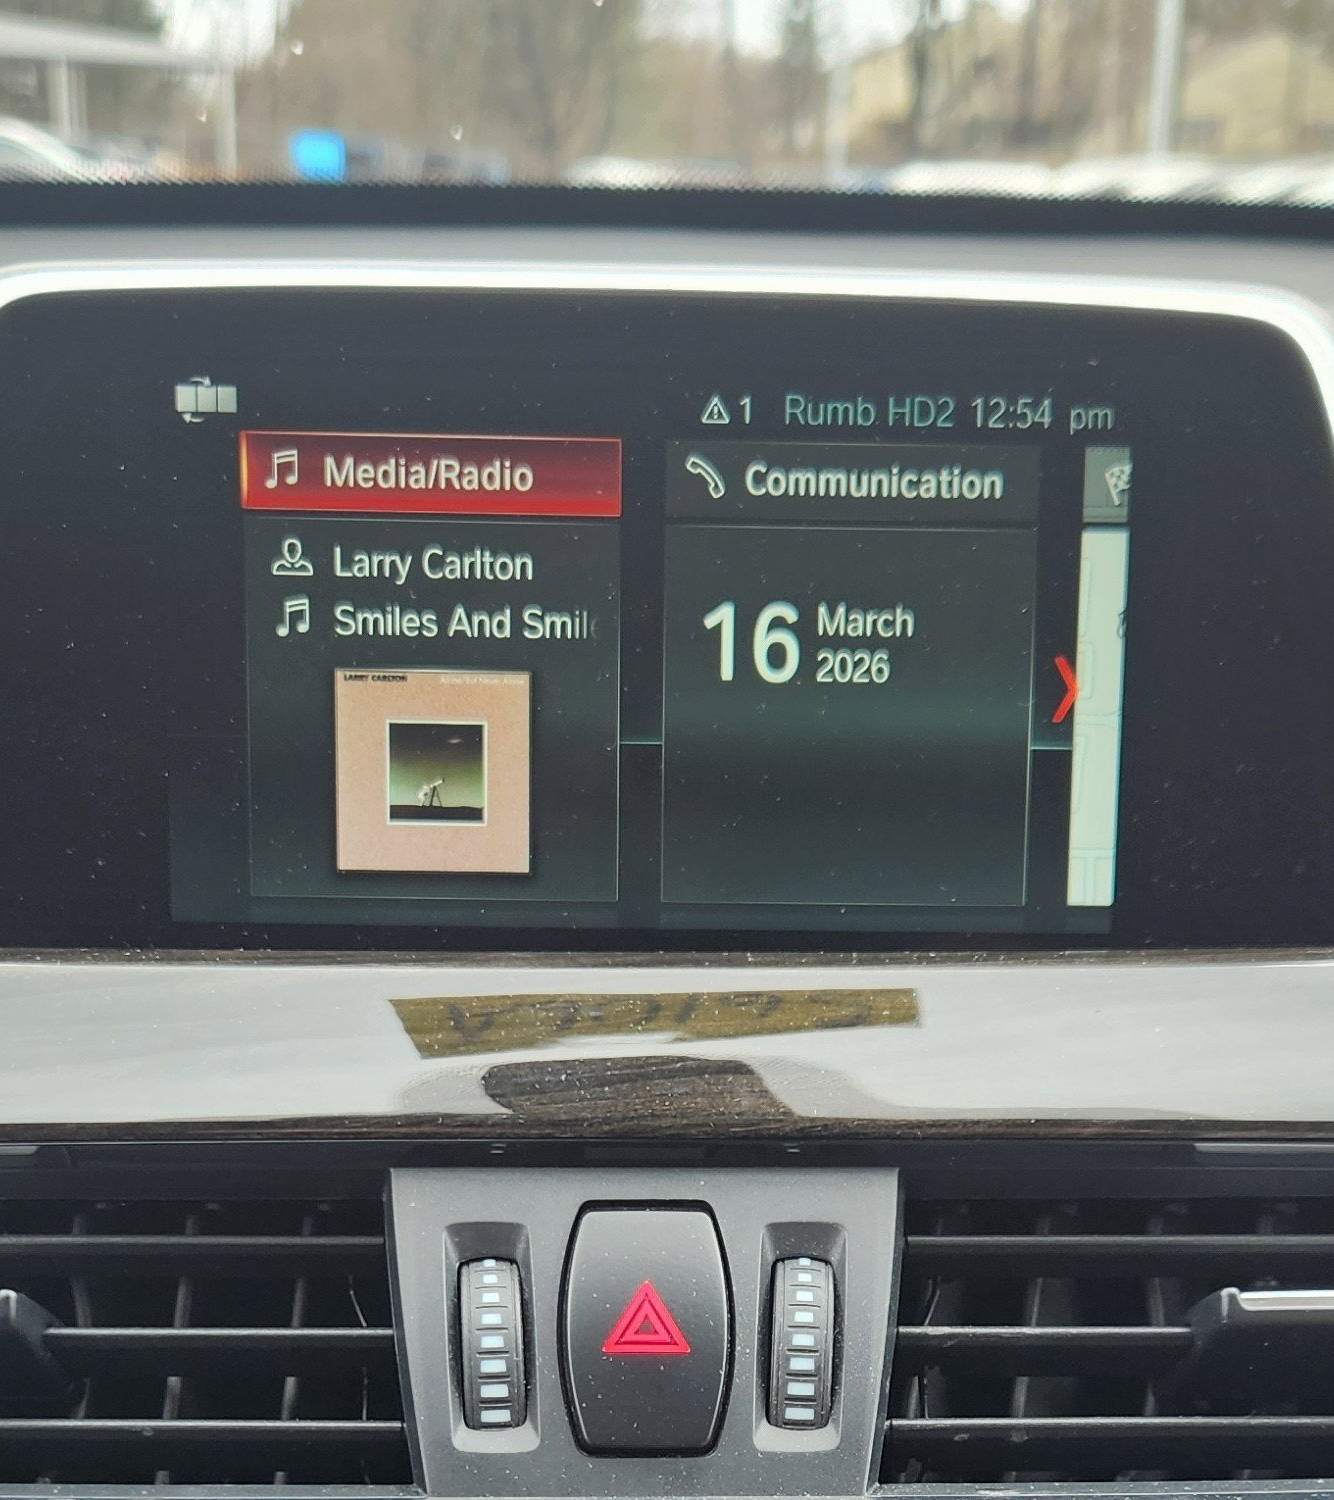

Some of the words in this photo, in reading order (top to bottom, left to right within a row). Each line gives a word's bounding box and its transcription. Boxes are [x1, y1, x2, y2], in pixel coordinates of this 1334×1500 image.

[784, 394, 875, 430] Rumb
[888, 398, 955, 430] HD2
[970, 397, 1053, 432] 12:54
[1070, 404, 1115, 434] pm
[323, 456, 535, 494] Media/Radio
[744, 461, 1005, 502] Communication
[333, 545, 412, 585] Larry
[421, 545, 534, 581] Carlton
[333, 604, 439, 638] Smiles
[447, 603, 512, 638] And
[816, 604, 915, 638] March
[703, 602, 801, 684] 16
[816, 652, 891, 686] 2026
